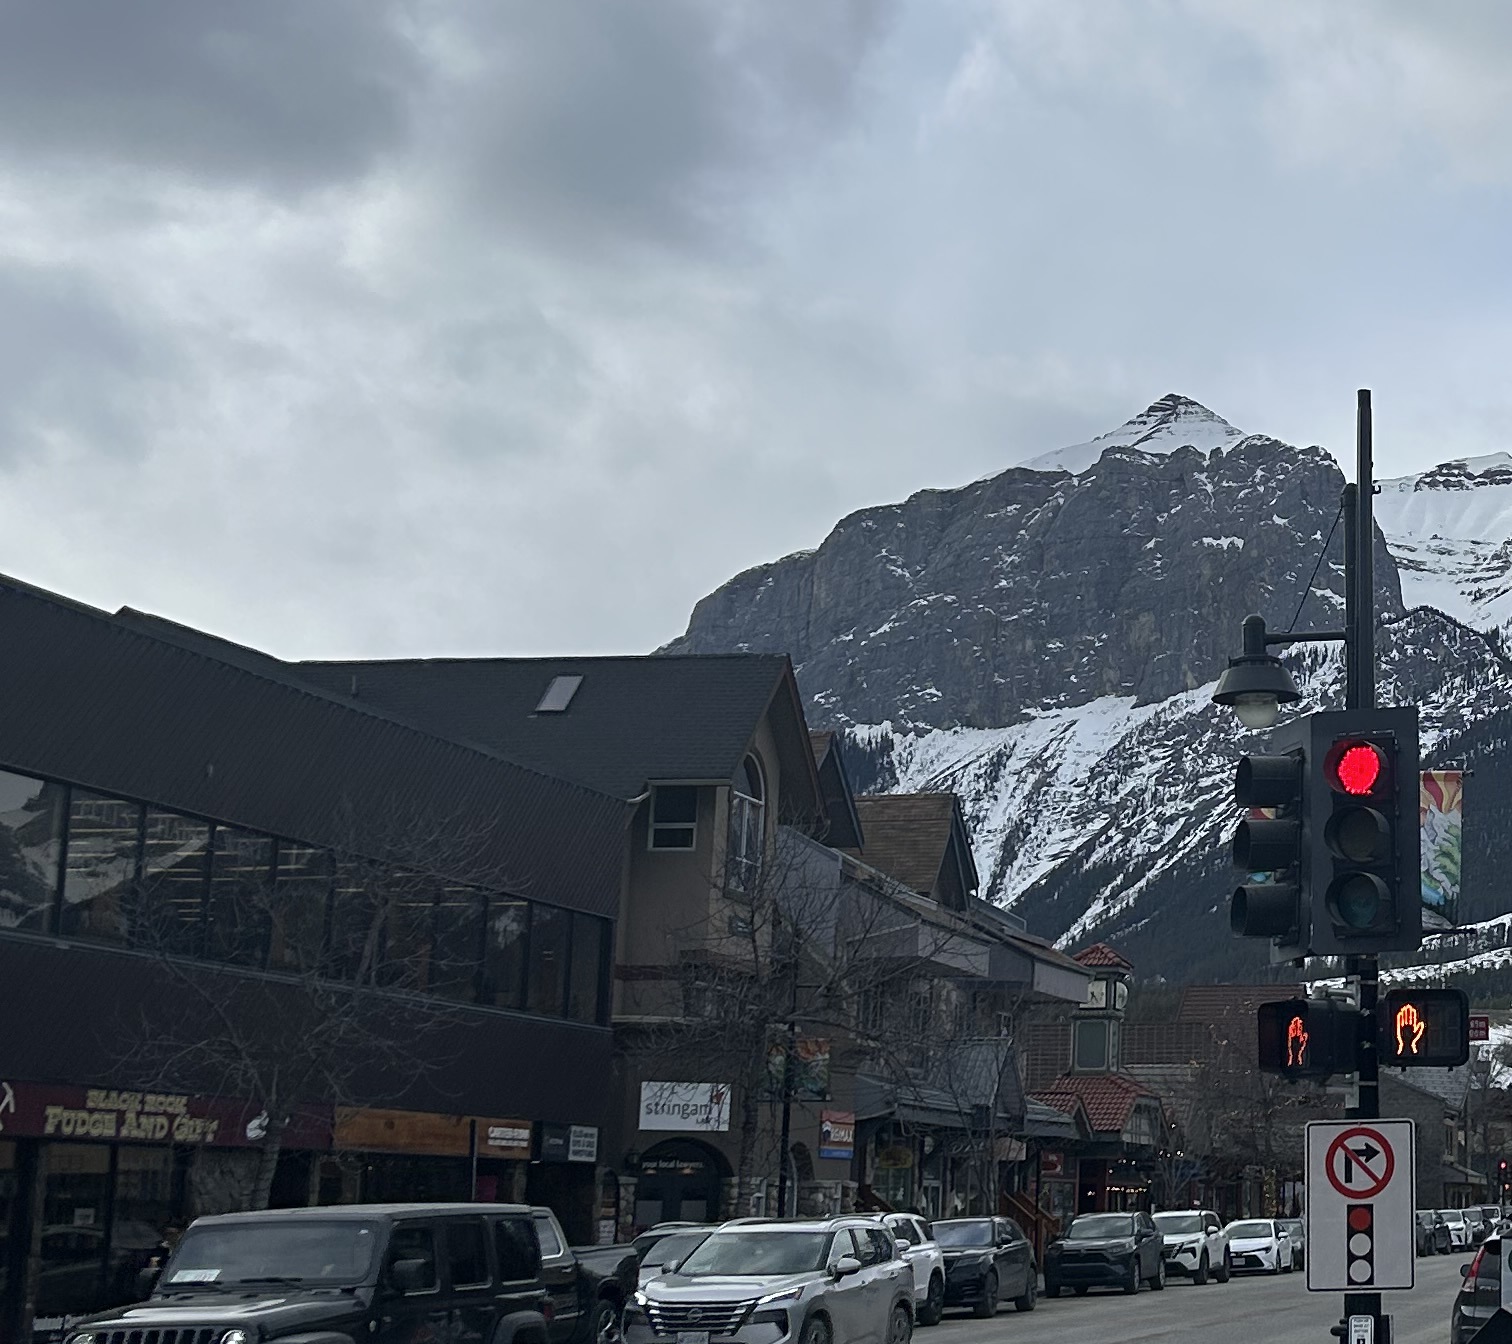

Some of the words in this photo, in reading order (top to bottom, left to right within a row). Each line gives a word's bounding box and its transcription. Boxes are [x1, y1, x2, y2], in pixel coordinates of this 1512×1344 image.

[44, 1105, 117, 1137] FUDGE
[120, 1110, 169, 1139] AND
[645, 1099, 712, 1120] stringam
